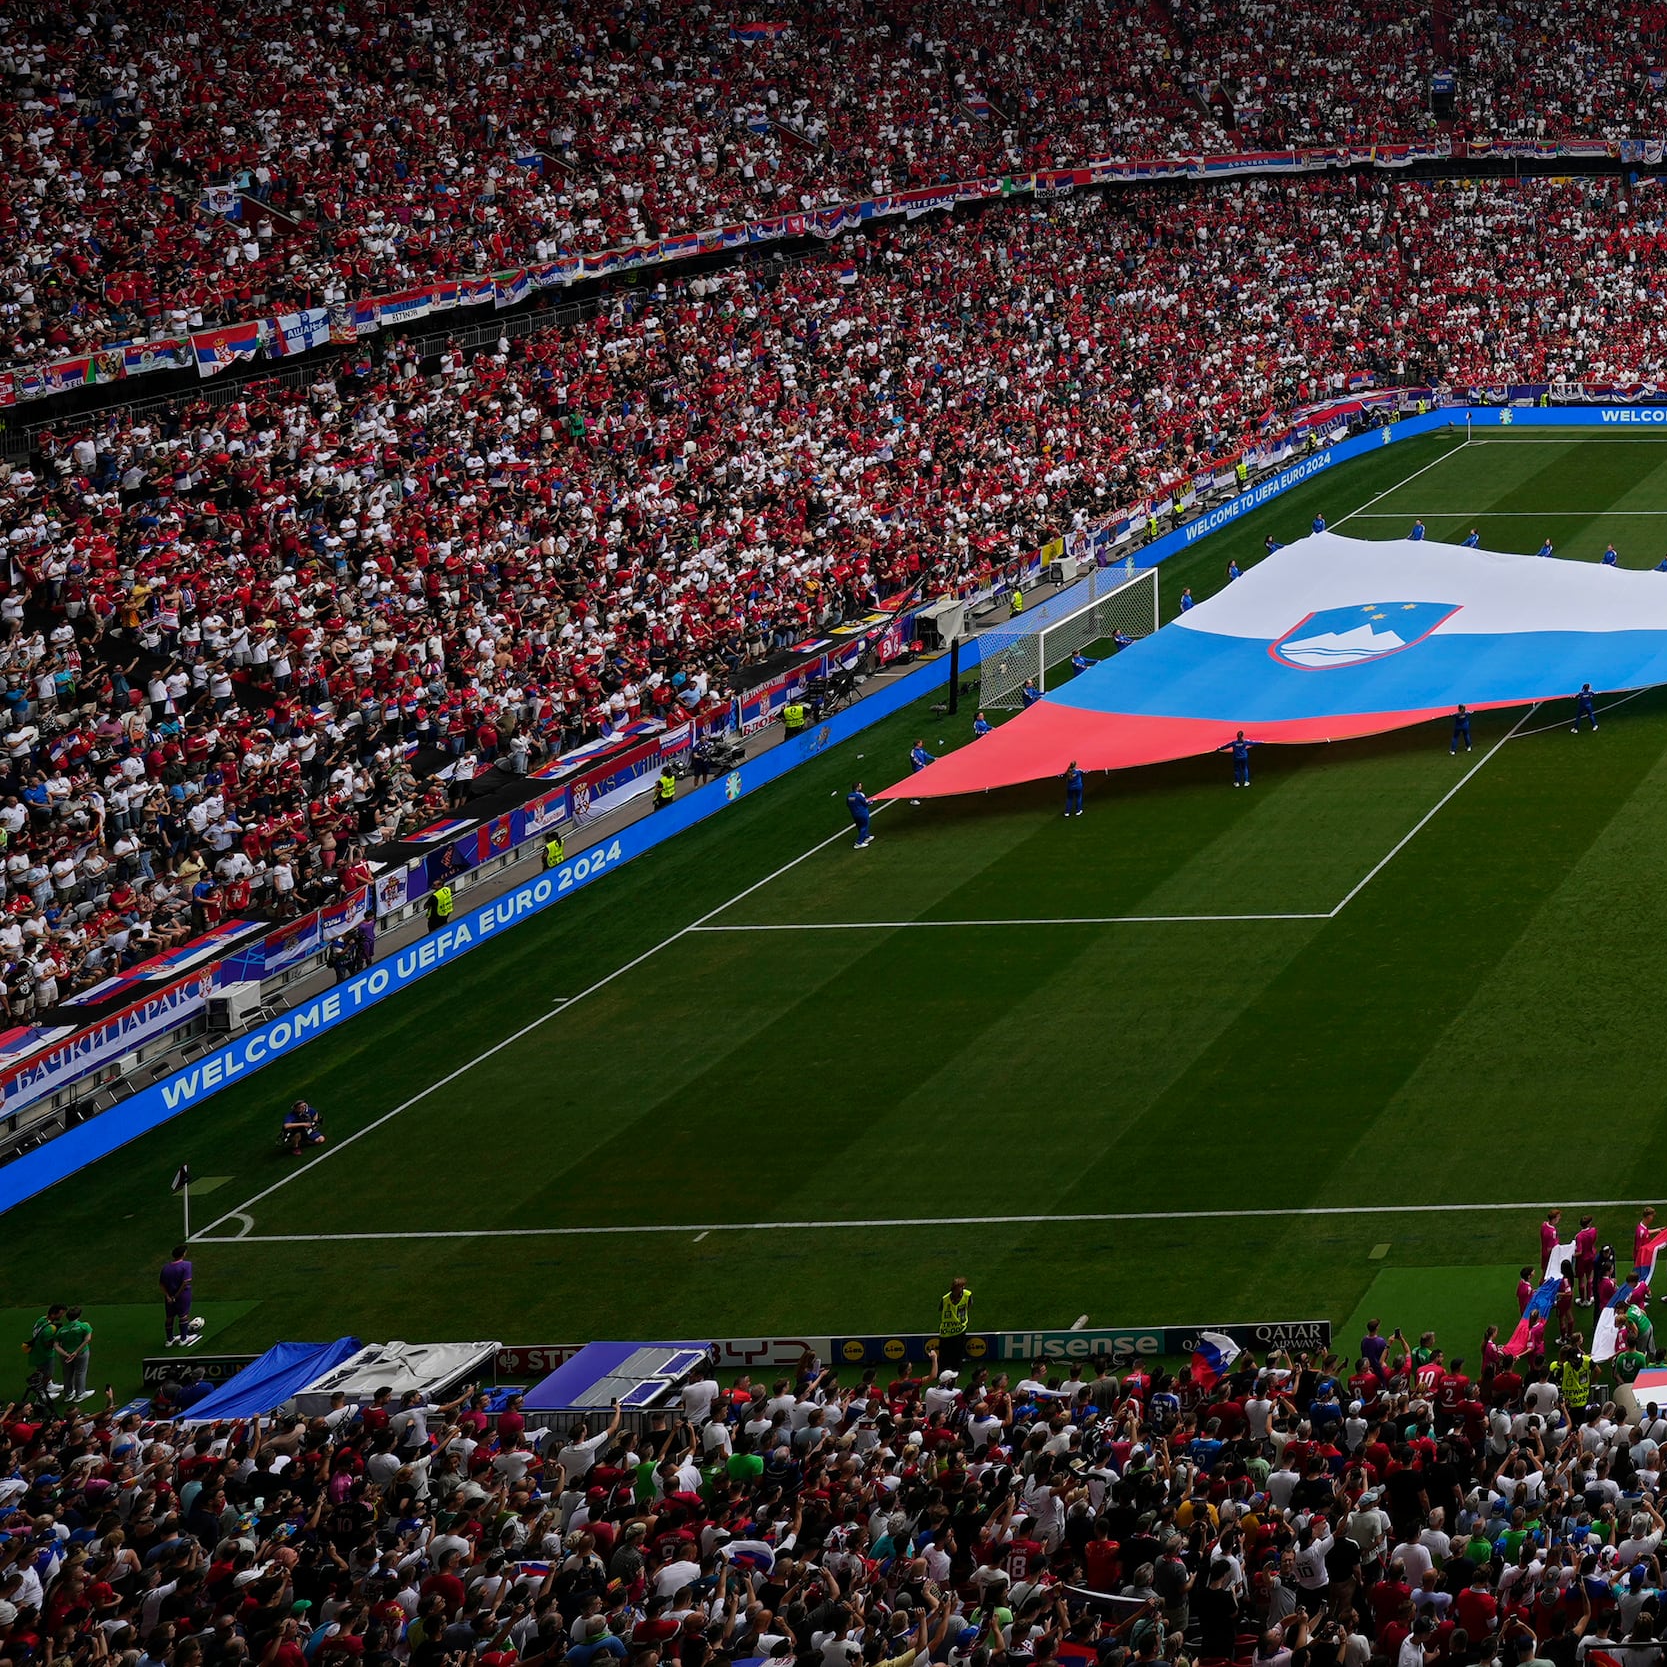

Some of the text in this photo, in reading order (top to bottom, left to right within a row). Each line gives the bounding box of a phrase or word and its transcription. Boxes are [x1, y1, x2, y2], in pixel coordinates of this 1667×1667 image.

[1185, 452, 1332, 542] WELCOME TO UEFA EURO 2024
[594, 779, 617, 796] VS
[160, 839, 624, 1109] WELCOME TO UEFA EURO 2024
[1255, 1324, 1321, 1340] QATAR
[1003, 1333, 1159, 1359] Hisense
